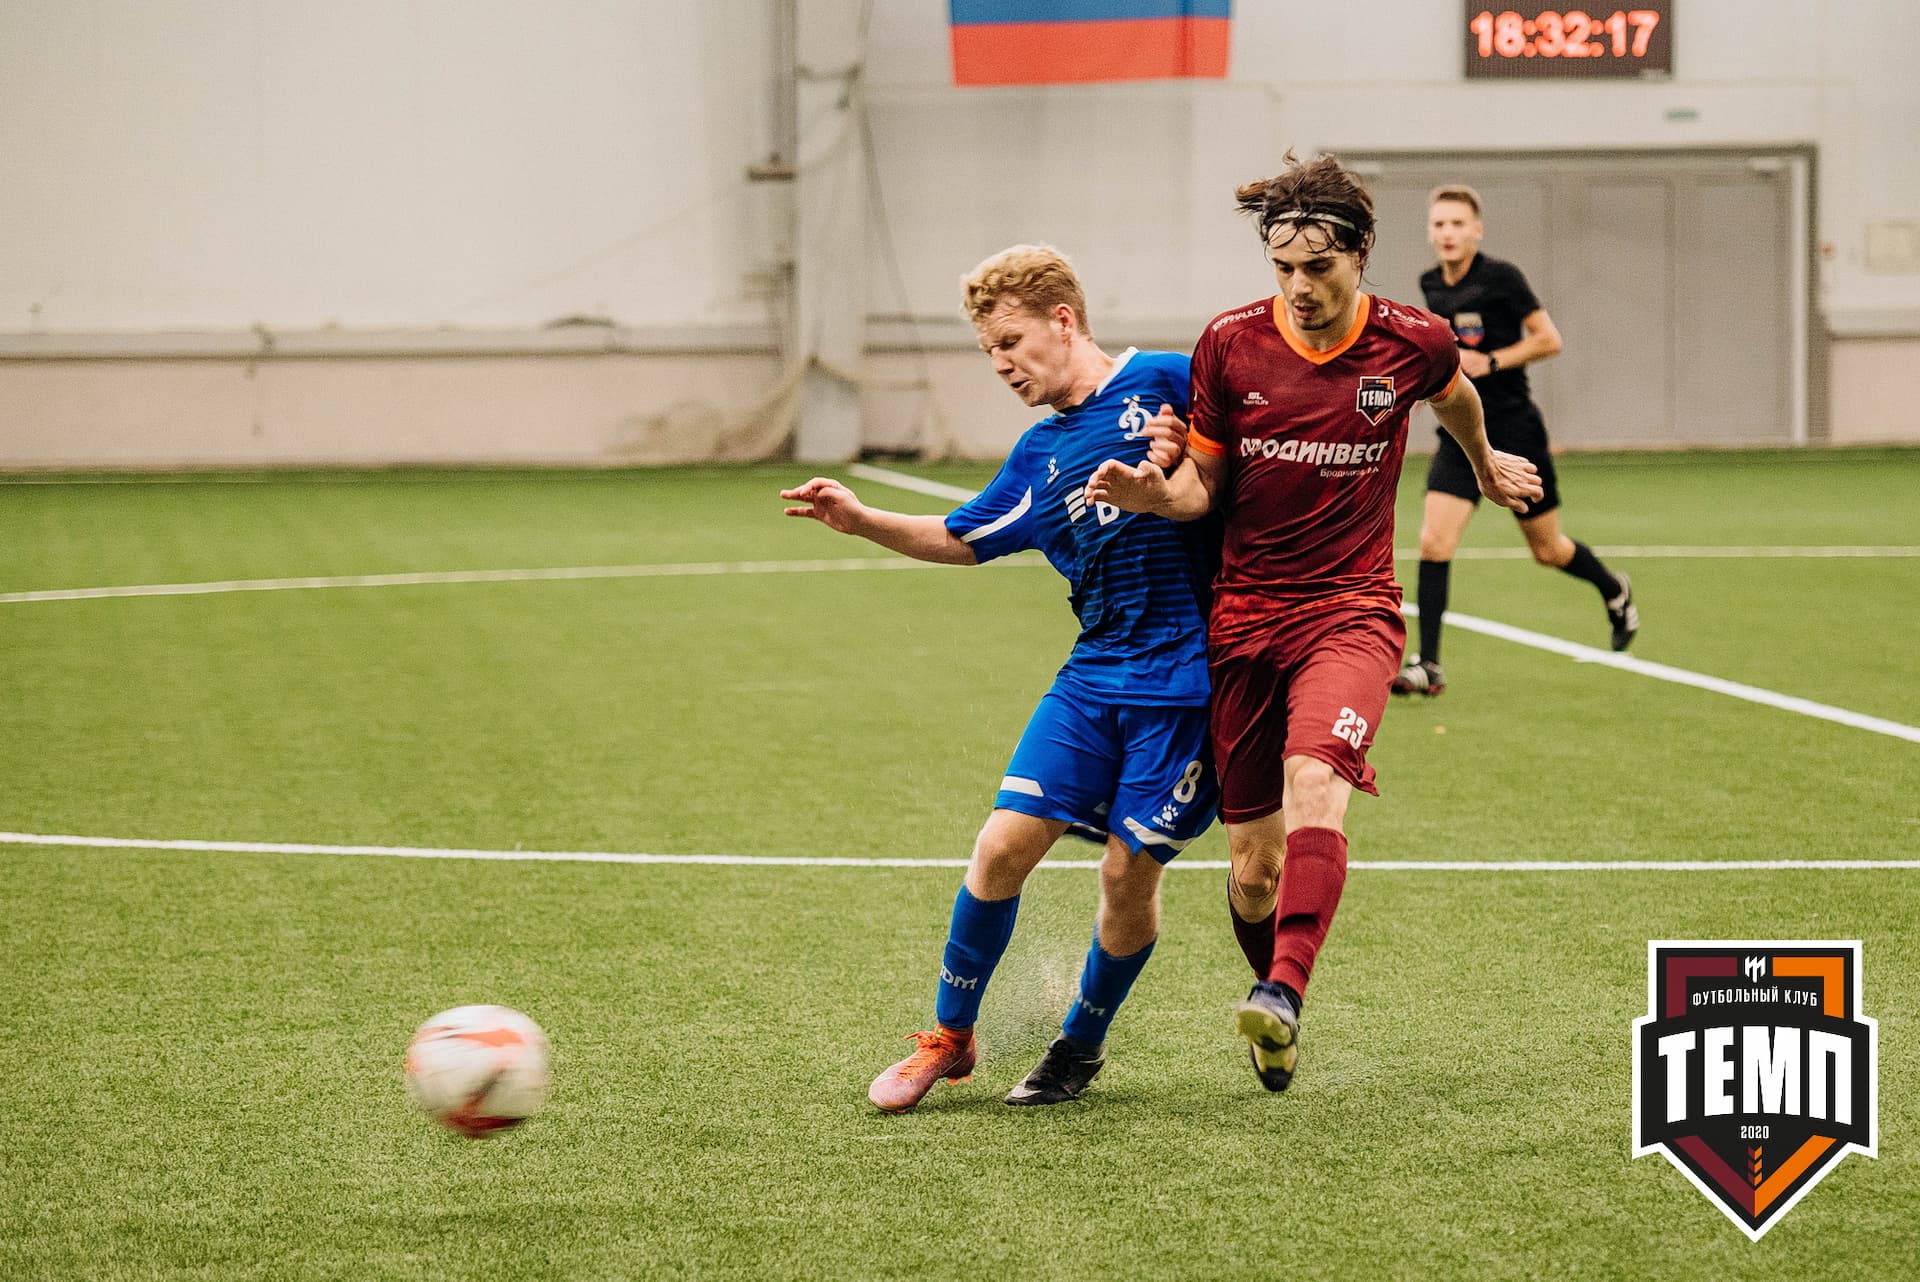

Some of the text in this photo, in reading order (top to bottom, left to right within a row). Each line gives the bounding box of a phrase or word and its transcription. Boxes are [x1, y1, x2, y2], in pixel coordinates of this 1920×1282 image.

[1470, 10, 1660, 58] 18:32:17
[1360, 390, 1393, 407] ТЕМП
[1240, 437, 1389, 466] ПРОДИНВЕСТ
[1331, 706, 1368, 750] 23
[1173, 760, 1203, 804] 8
